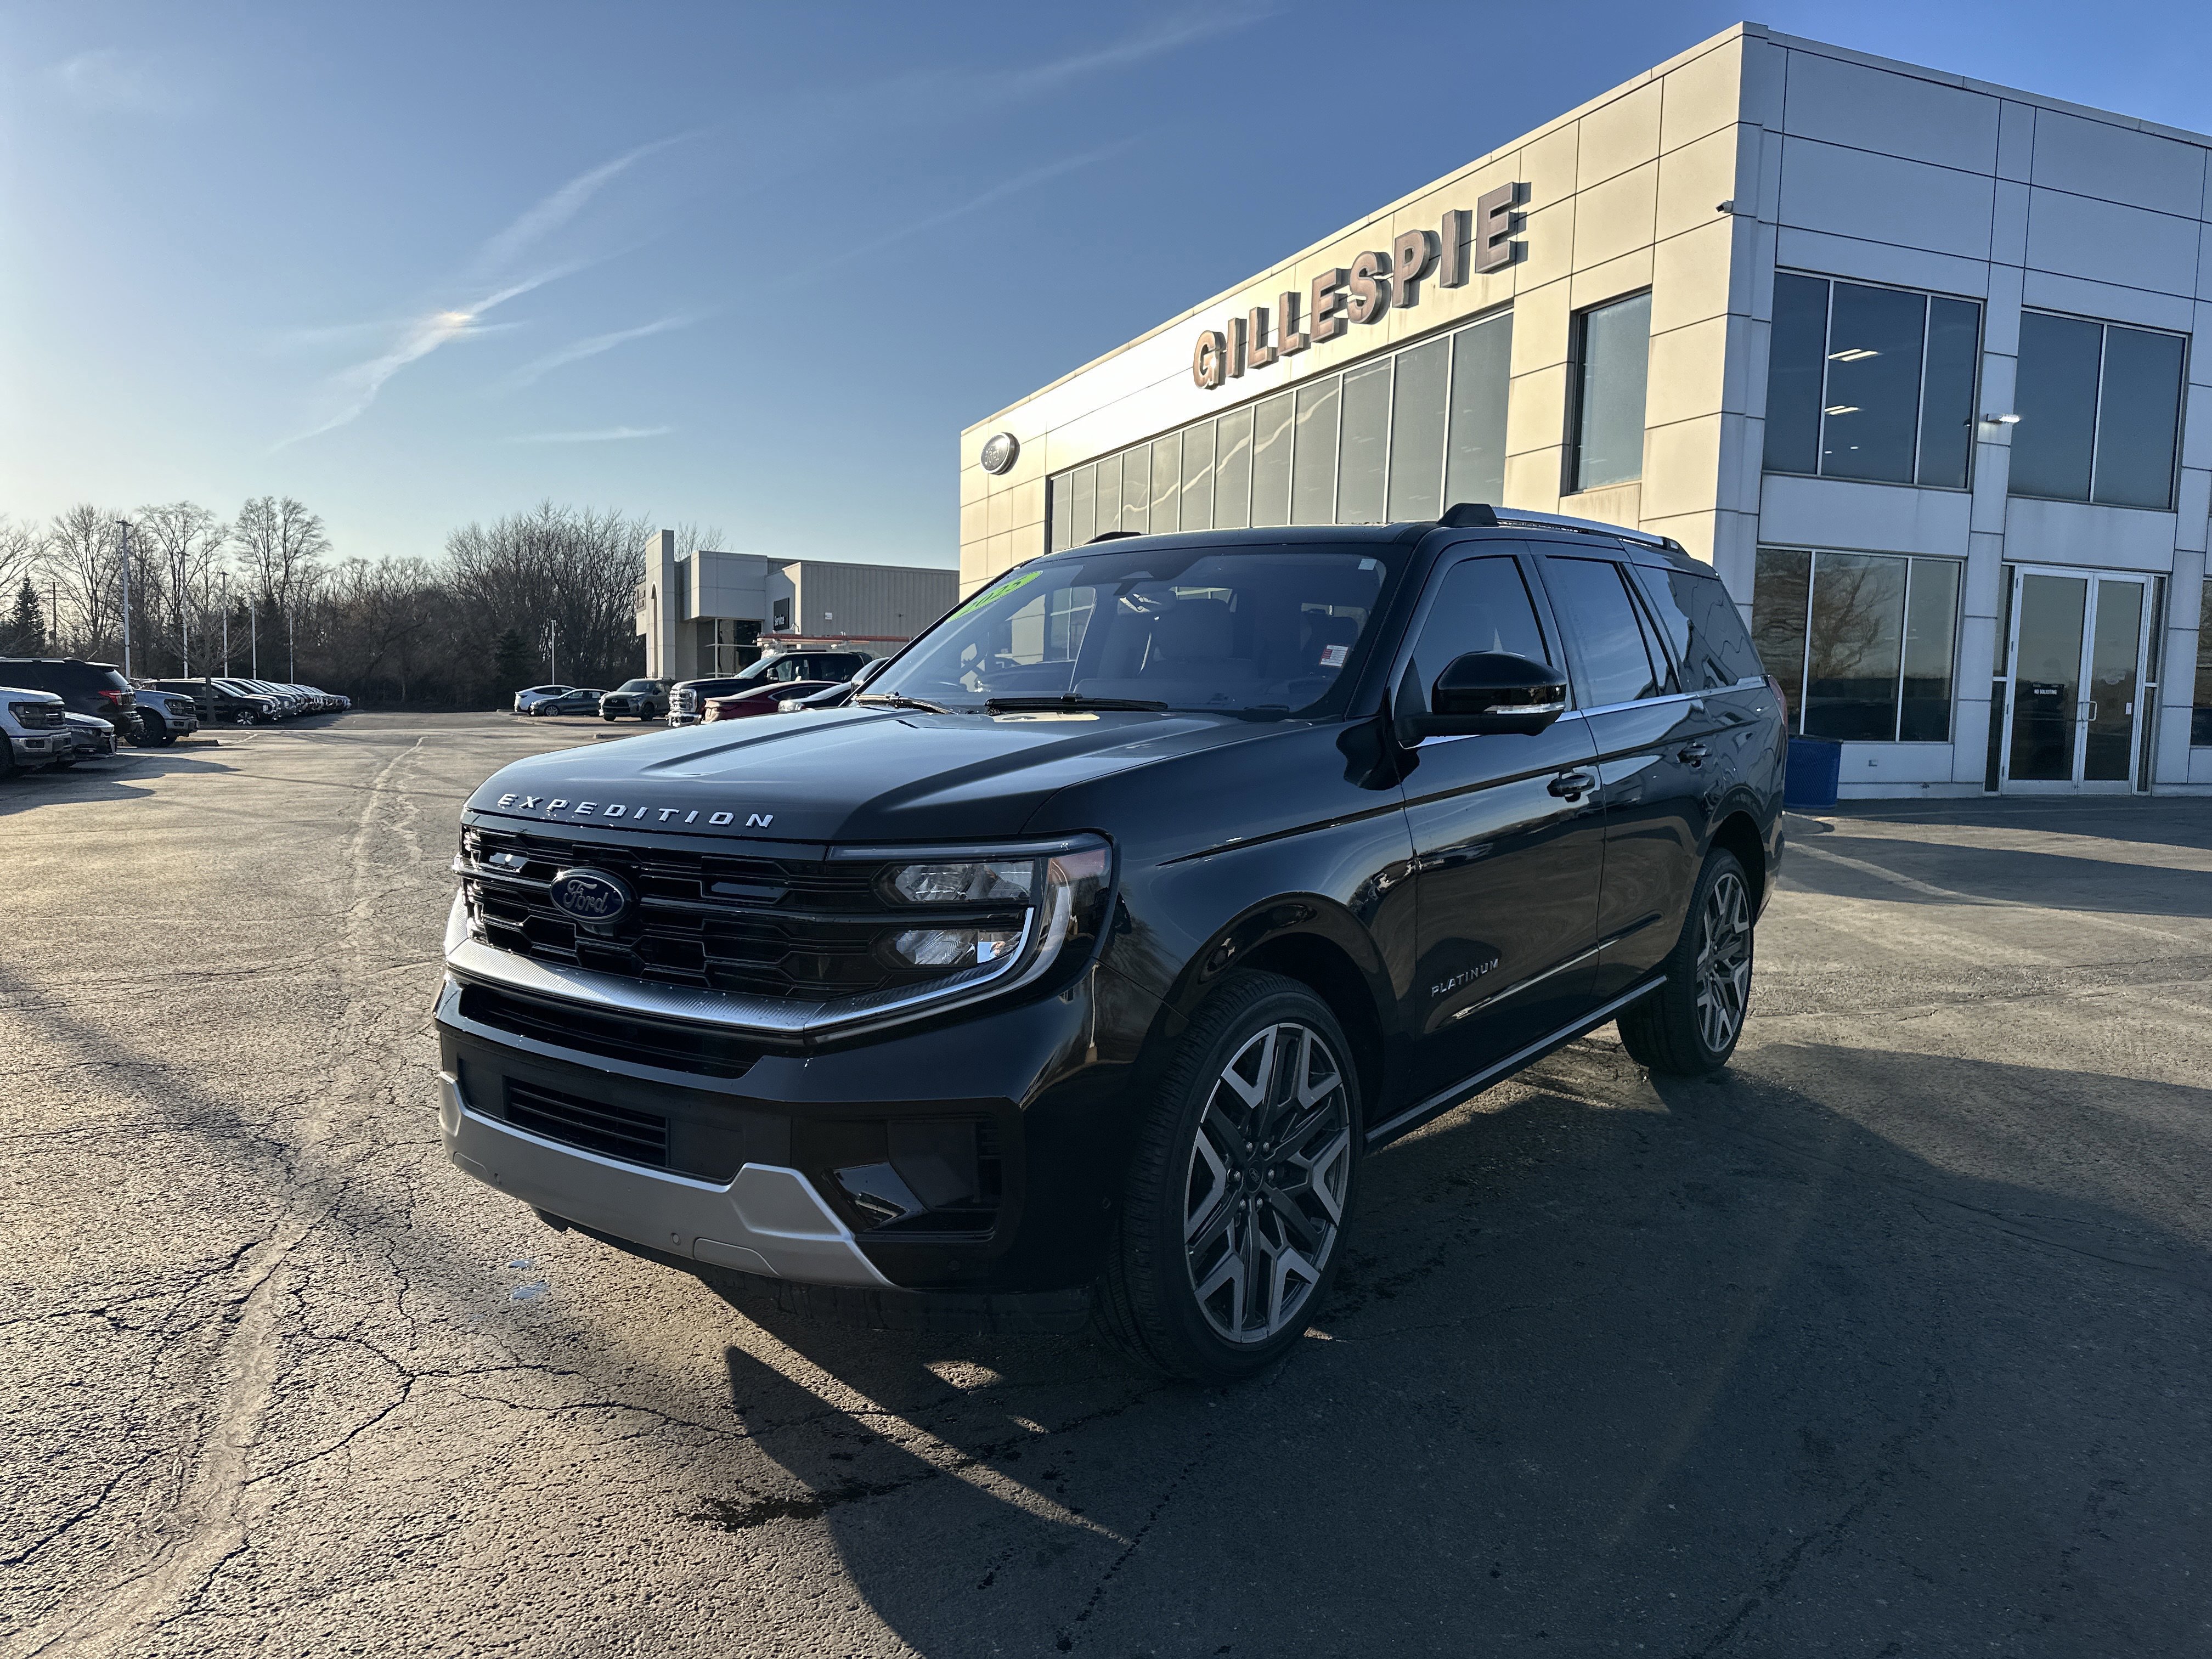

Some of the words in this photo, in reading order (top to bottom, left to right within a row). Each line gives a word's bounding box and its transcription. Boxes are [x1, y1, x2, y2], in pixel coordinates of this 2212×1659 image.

[1193, 182, 1523, 390] GILLESPIE
[496, 793, 774, 828] EXPEDITION
[563, 879, 609, 914] Ford
[1431, 958, 1498, 997] PLATINUM
